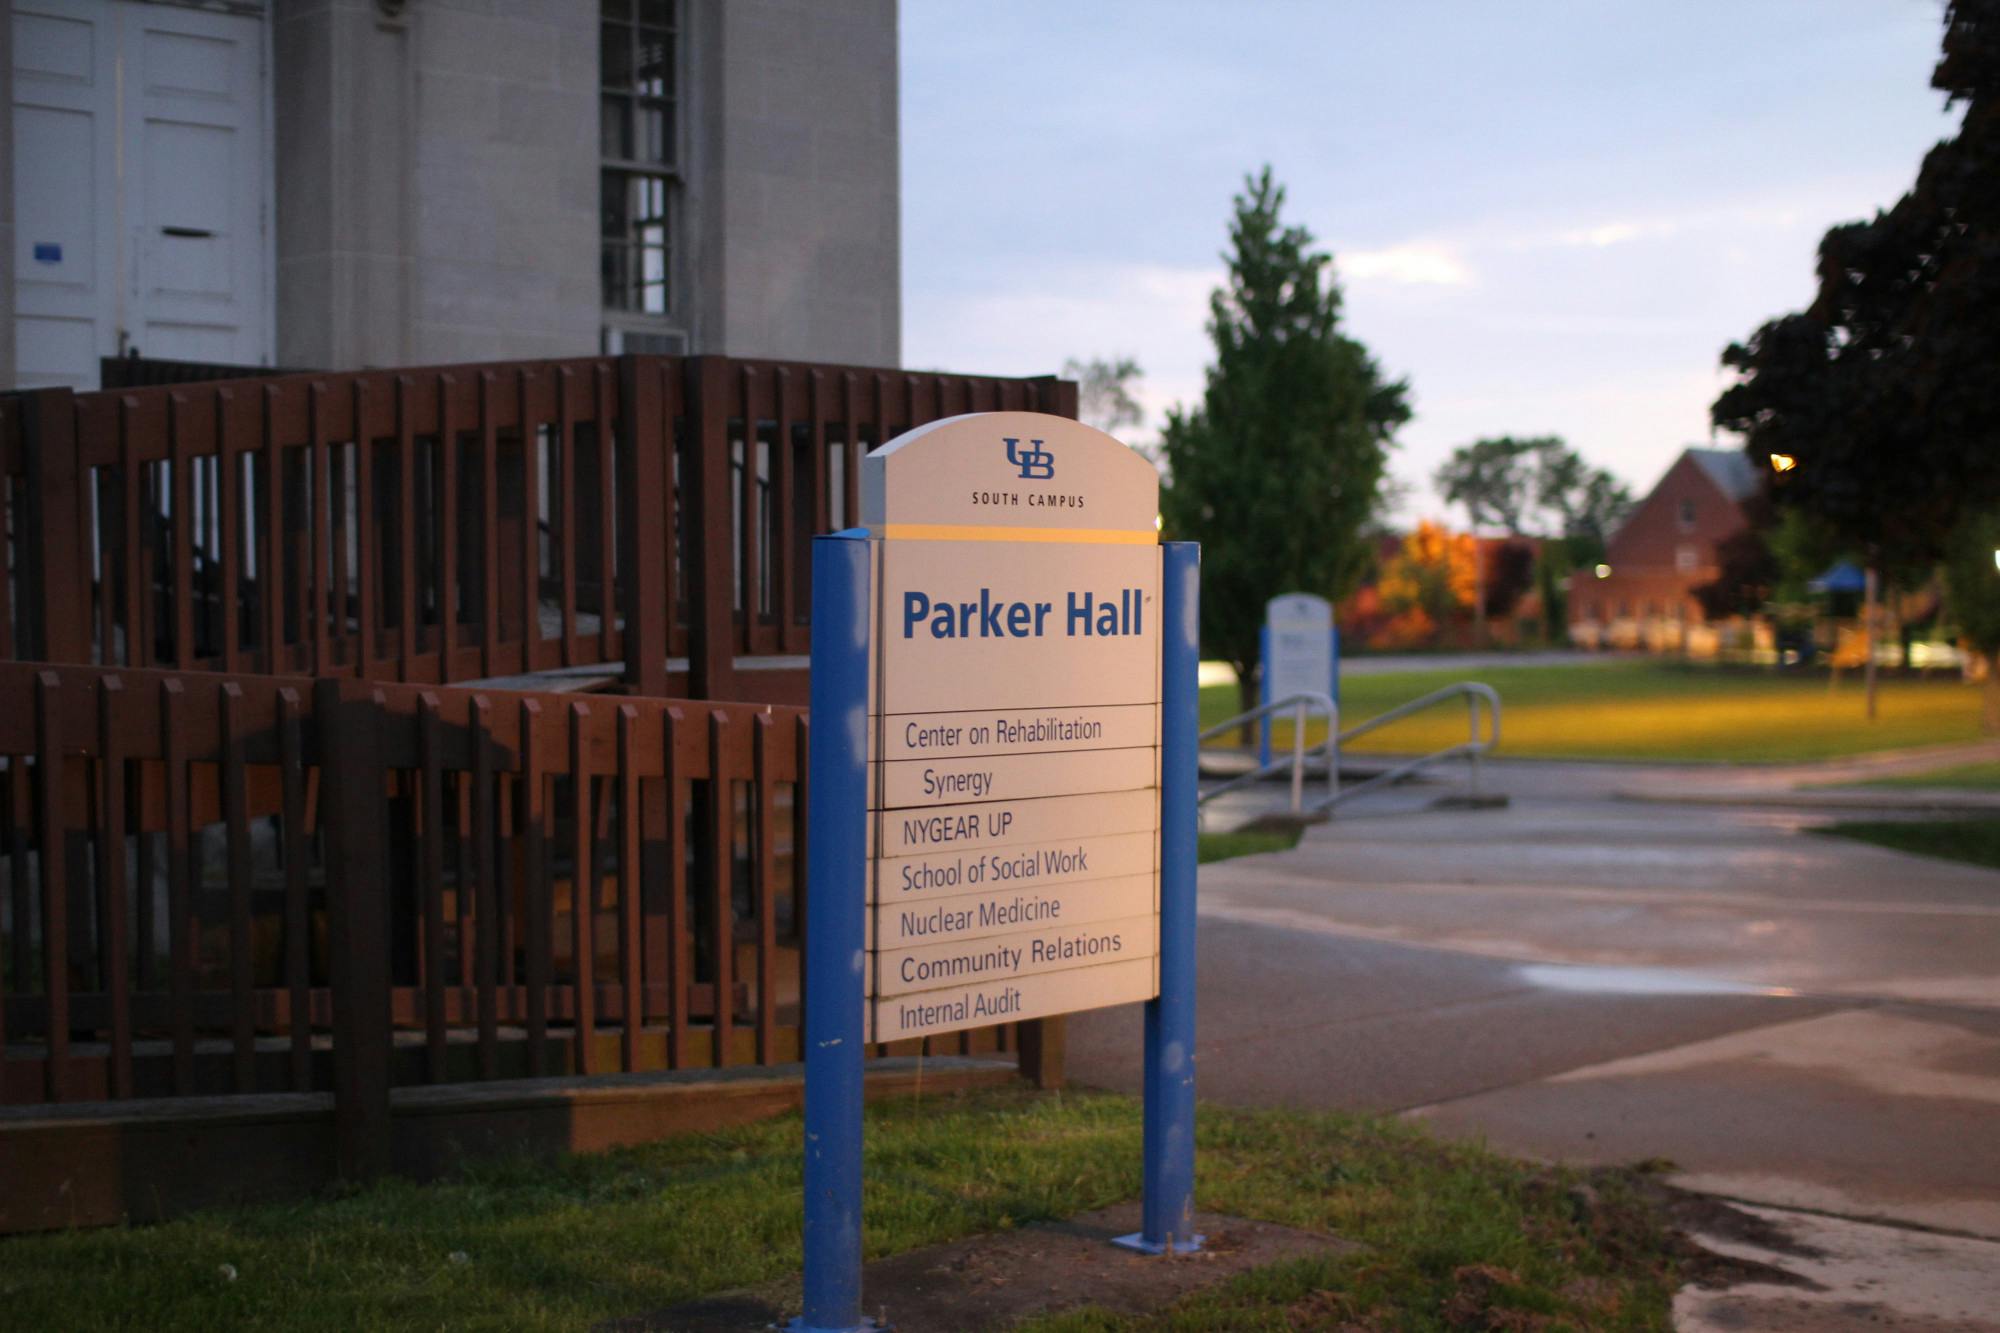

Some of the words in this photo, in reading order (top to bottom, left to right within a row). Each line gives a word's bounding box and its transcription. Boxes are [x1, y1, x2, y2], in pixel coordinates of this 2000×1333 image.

[1002, 438, 1055, 480] UB
[972, 491, 1019, 506] SOUTH
[1028, 493, 1085, 508] CAMPUS
[903, 588, 1052, 639] Parker
[1066, 588, 1143, 637] Hall
[906, 721, 963, 749] Center
[969, 725, 990, 746] on
[996, 716, 1102, 744] Rehabilitation
[923, 768, 993, 799] Synergy
[903, 814, 980, 845] NYGEAR
[988, 811, 1013, 838] UP
[902, 859, 962, 891] School
[968, 855, 987, 884] of
[991, 850, 1040, 881] Social
[1044, 846, 1088, 875] Work
[901, 906, 974, 938] Nuclear
[979, 896, 1061, 928] Medicine
[901, 944, 1022, 983] Community
[1031, 933, 1122, 964] Relations
[900, 994, 969, 1030] Internal
[974, 987, 1022, 1018] Audit
